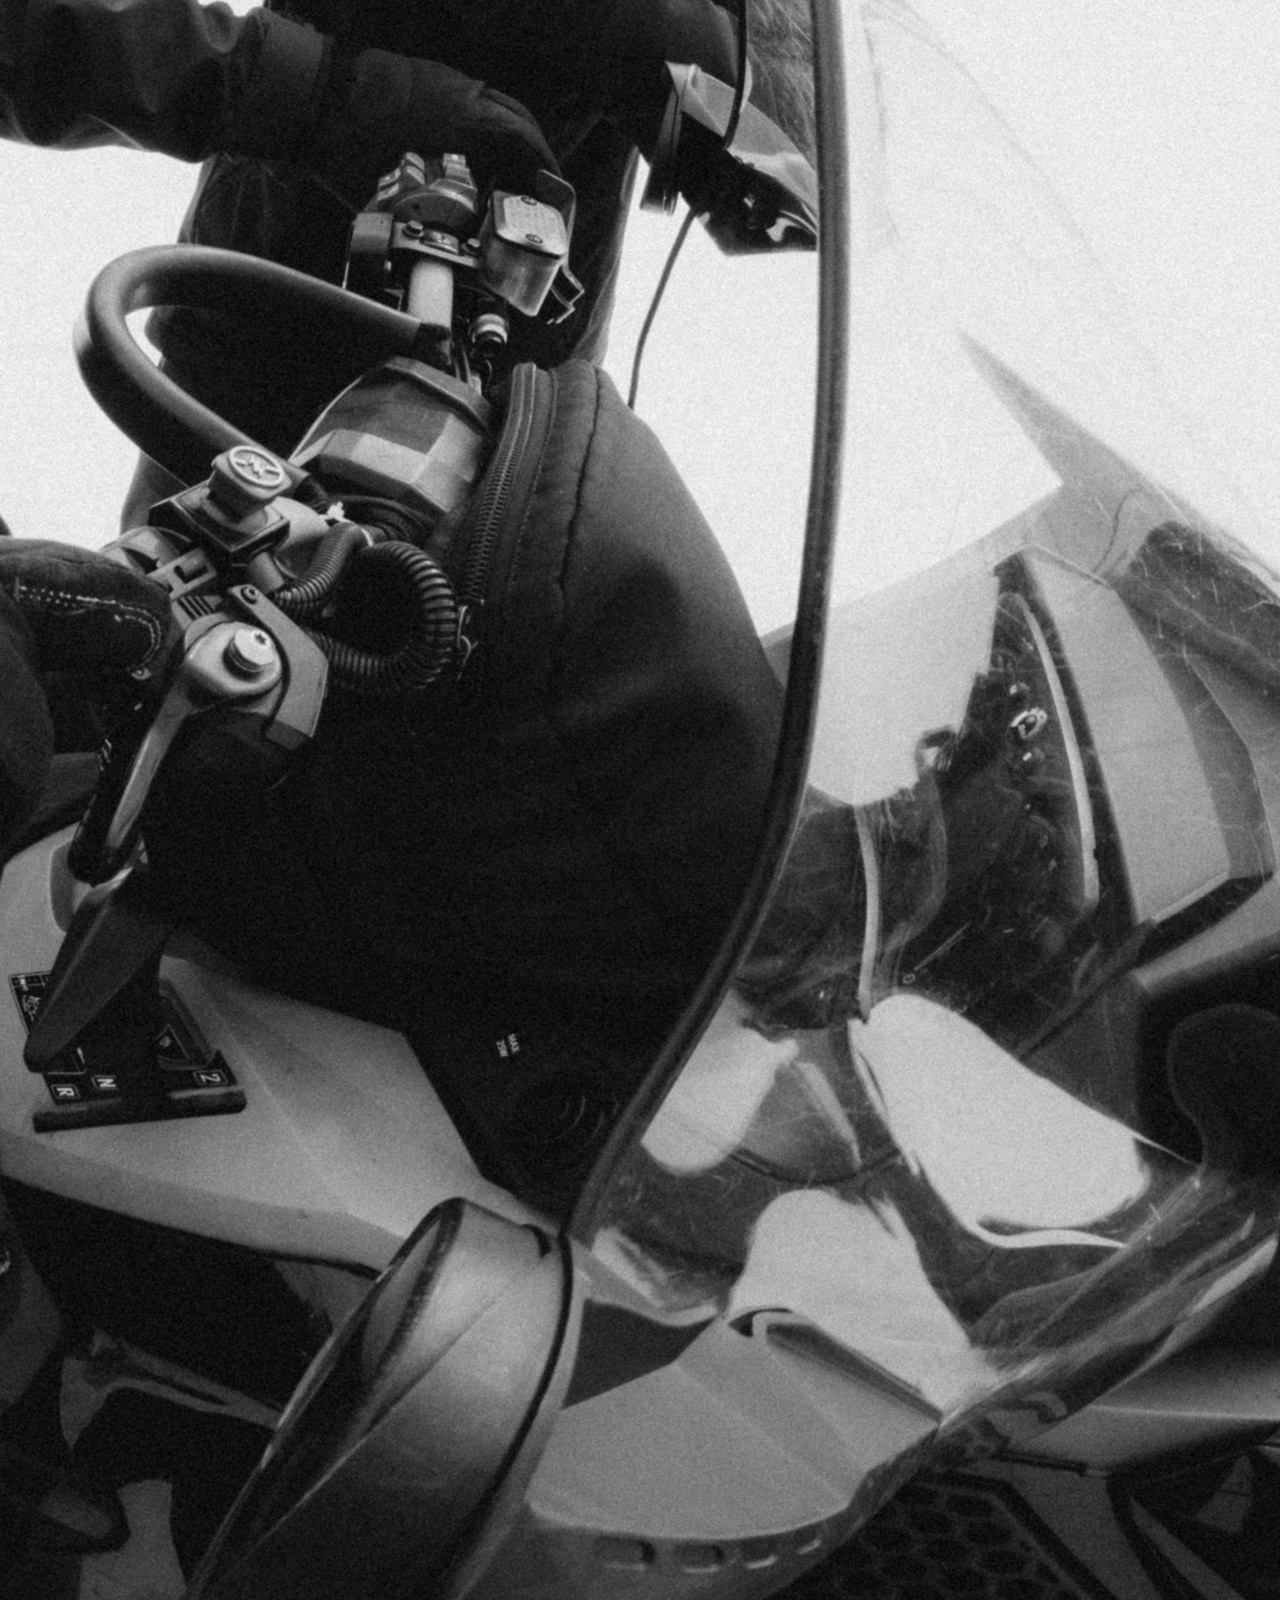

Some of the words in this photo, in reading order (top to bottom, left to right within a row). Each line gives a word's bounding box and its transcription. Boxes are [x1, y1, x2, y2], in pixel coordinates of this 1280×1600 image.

[96, 1077, 117, 1088] N
[200, 1072, 221, 1083] 2
[56, 1086, 75, 1097] R
